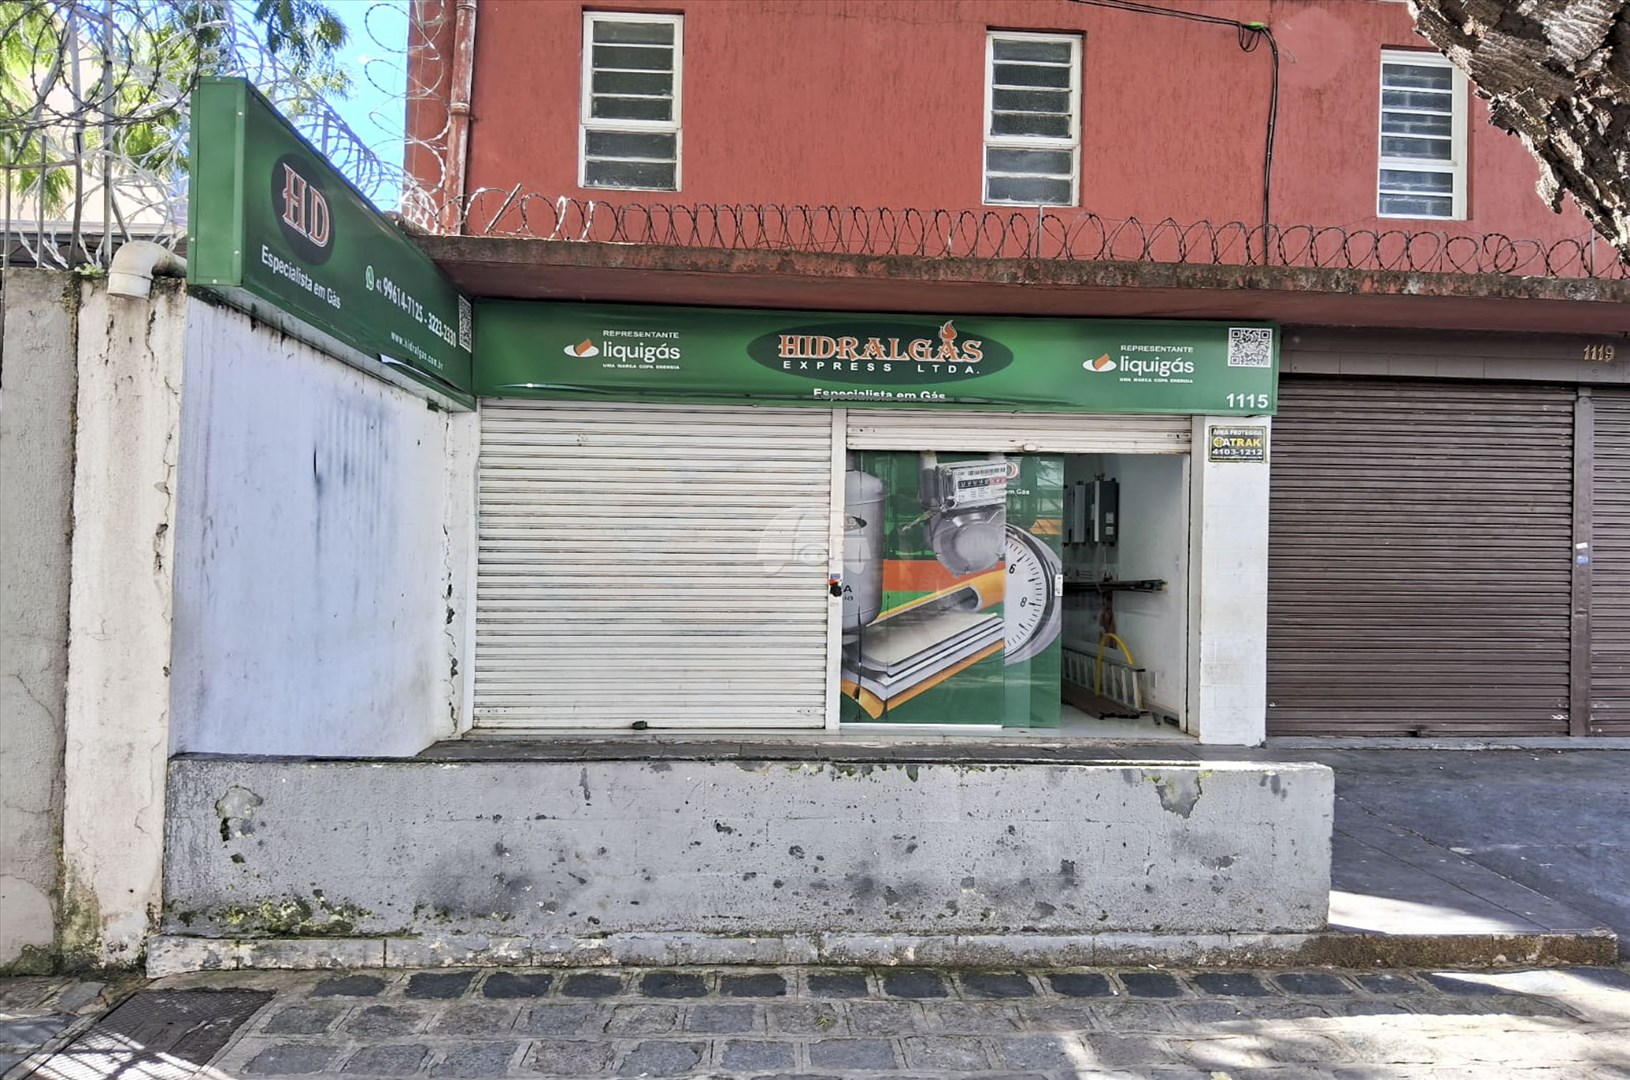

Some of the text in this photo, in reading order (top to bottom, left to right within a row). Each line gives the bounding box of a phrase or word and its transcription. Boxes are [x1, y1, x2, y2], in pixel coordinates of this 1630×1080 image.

[282, 162, 330, 248] HD
[261, 244, 341, 309] Especialista em Gás
[603, 330, 679, 339] REPRESENTANTE
[603, 341, 681, 363] liquigás
[1120, 345, 1194, 353] REPRESENTANTE
[1583, 344, 1615, 362] 1119
[783, 360, 980, 375] EXPRESS LTDA.
[1120, 355, 1195, 377] liquigás
[1226, 393, 1269, 409] 1115
[1212, 448, 1263, 456] 4103-1212
[1009, 563, 1016, 574] 6
[1020, 596, 1027, 608] 8
